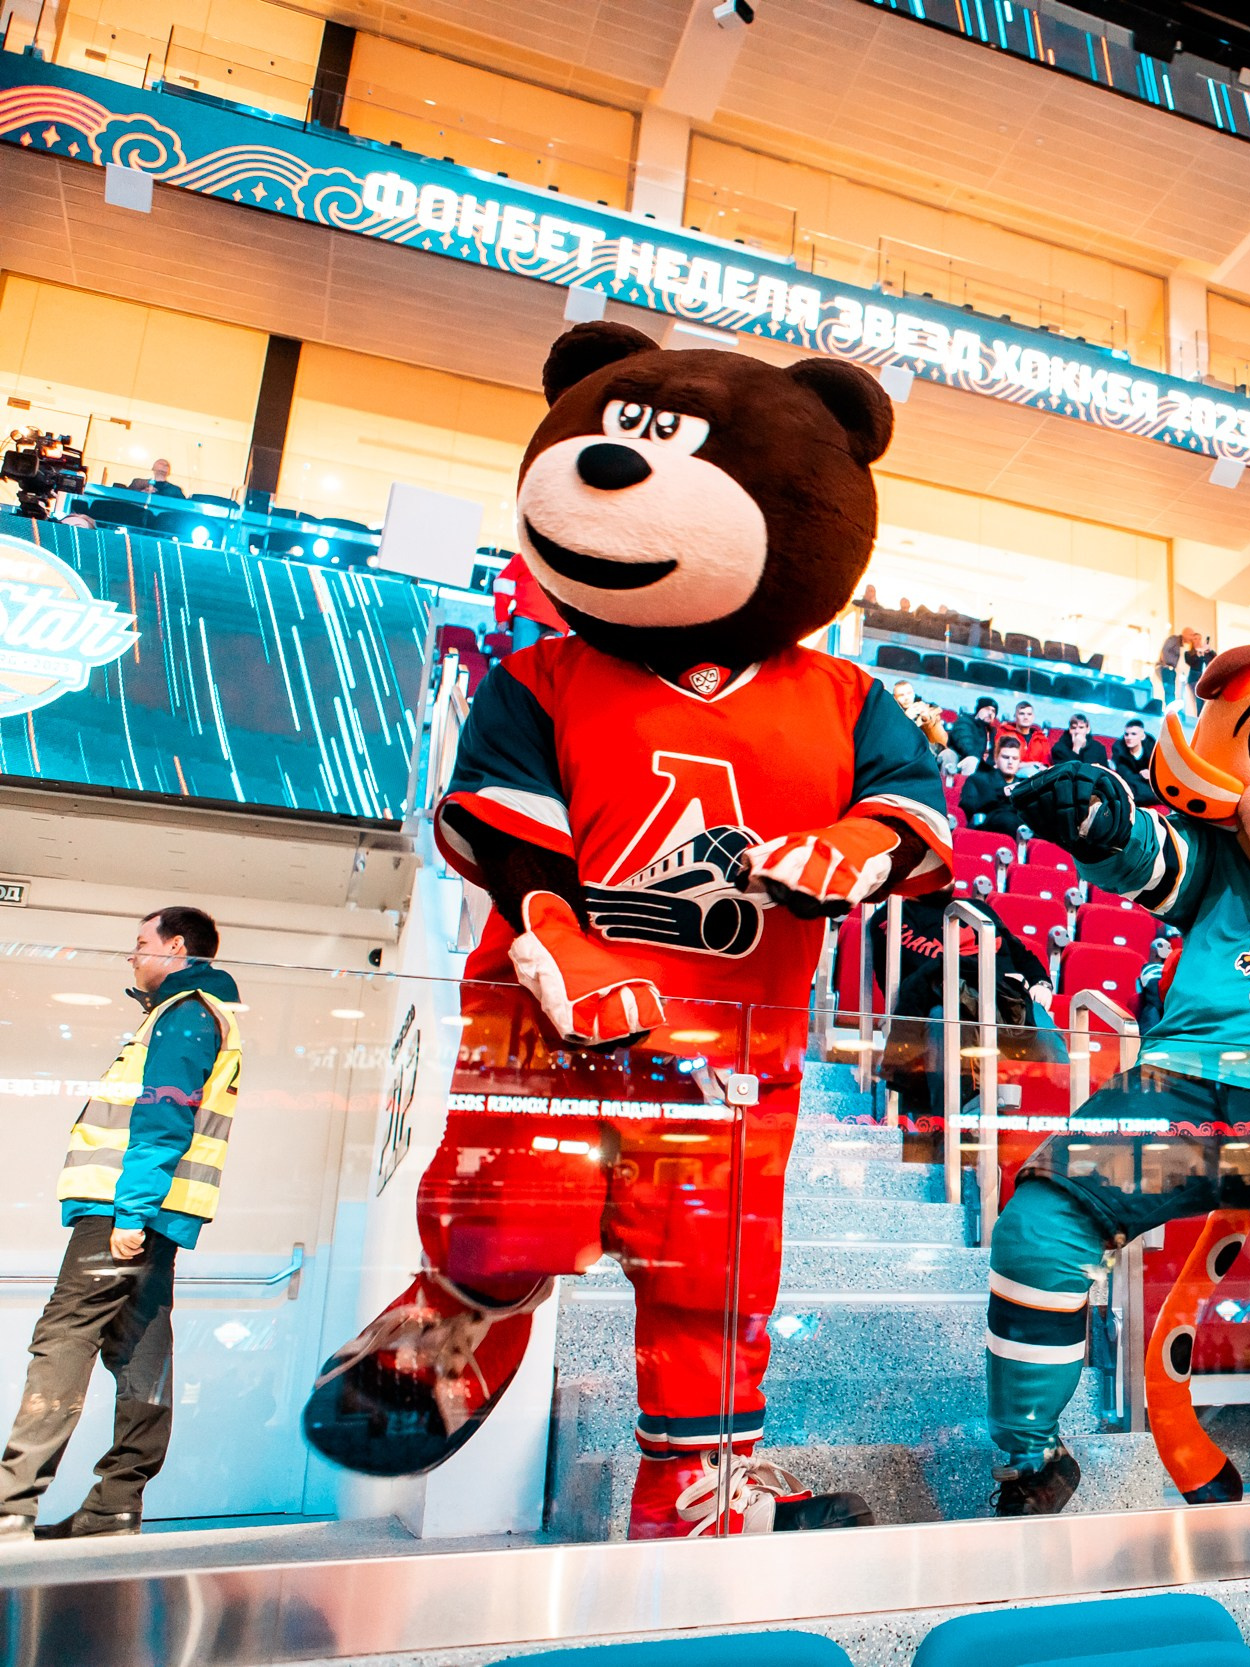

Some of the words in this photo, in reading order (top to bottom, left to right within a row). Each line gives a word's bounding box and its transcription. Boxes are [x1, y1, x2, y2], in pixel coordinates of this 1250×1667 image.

[362, 171, 606, 270] ФОНБЕТ
[615, 236, 822, 331] НЕДЕЛЯ
[833, 296, 983, 381] ЗВЕЗД
[991, 339, 1159, 423] ХОККЕЯ
